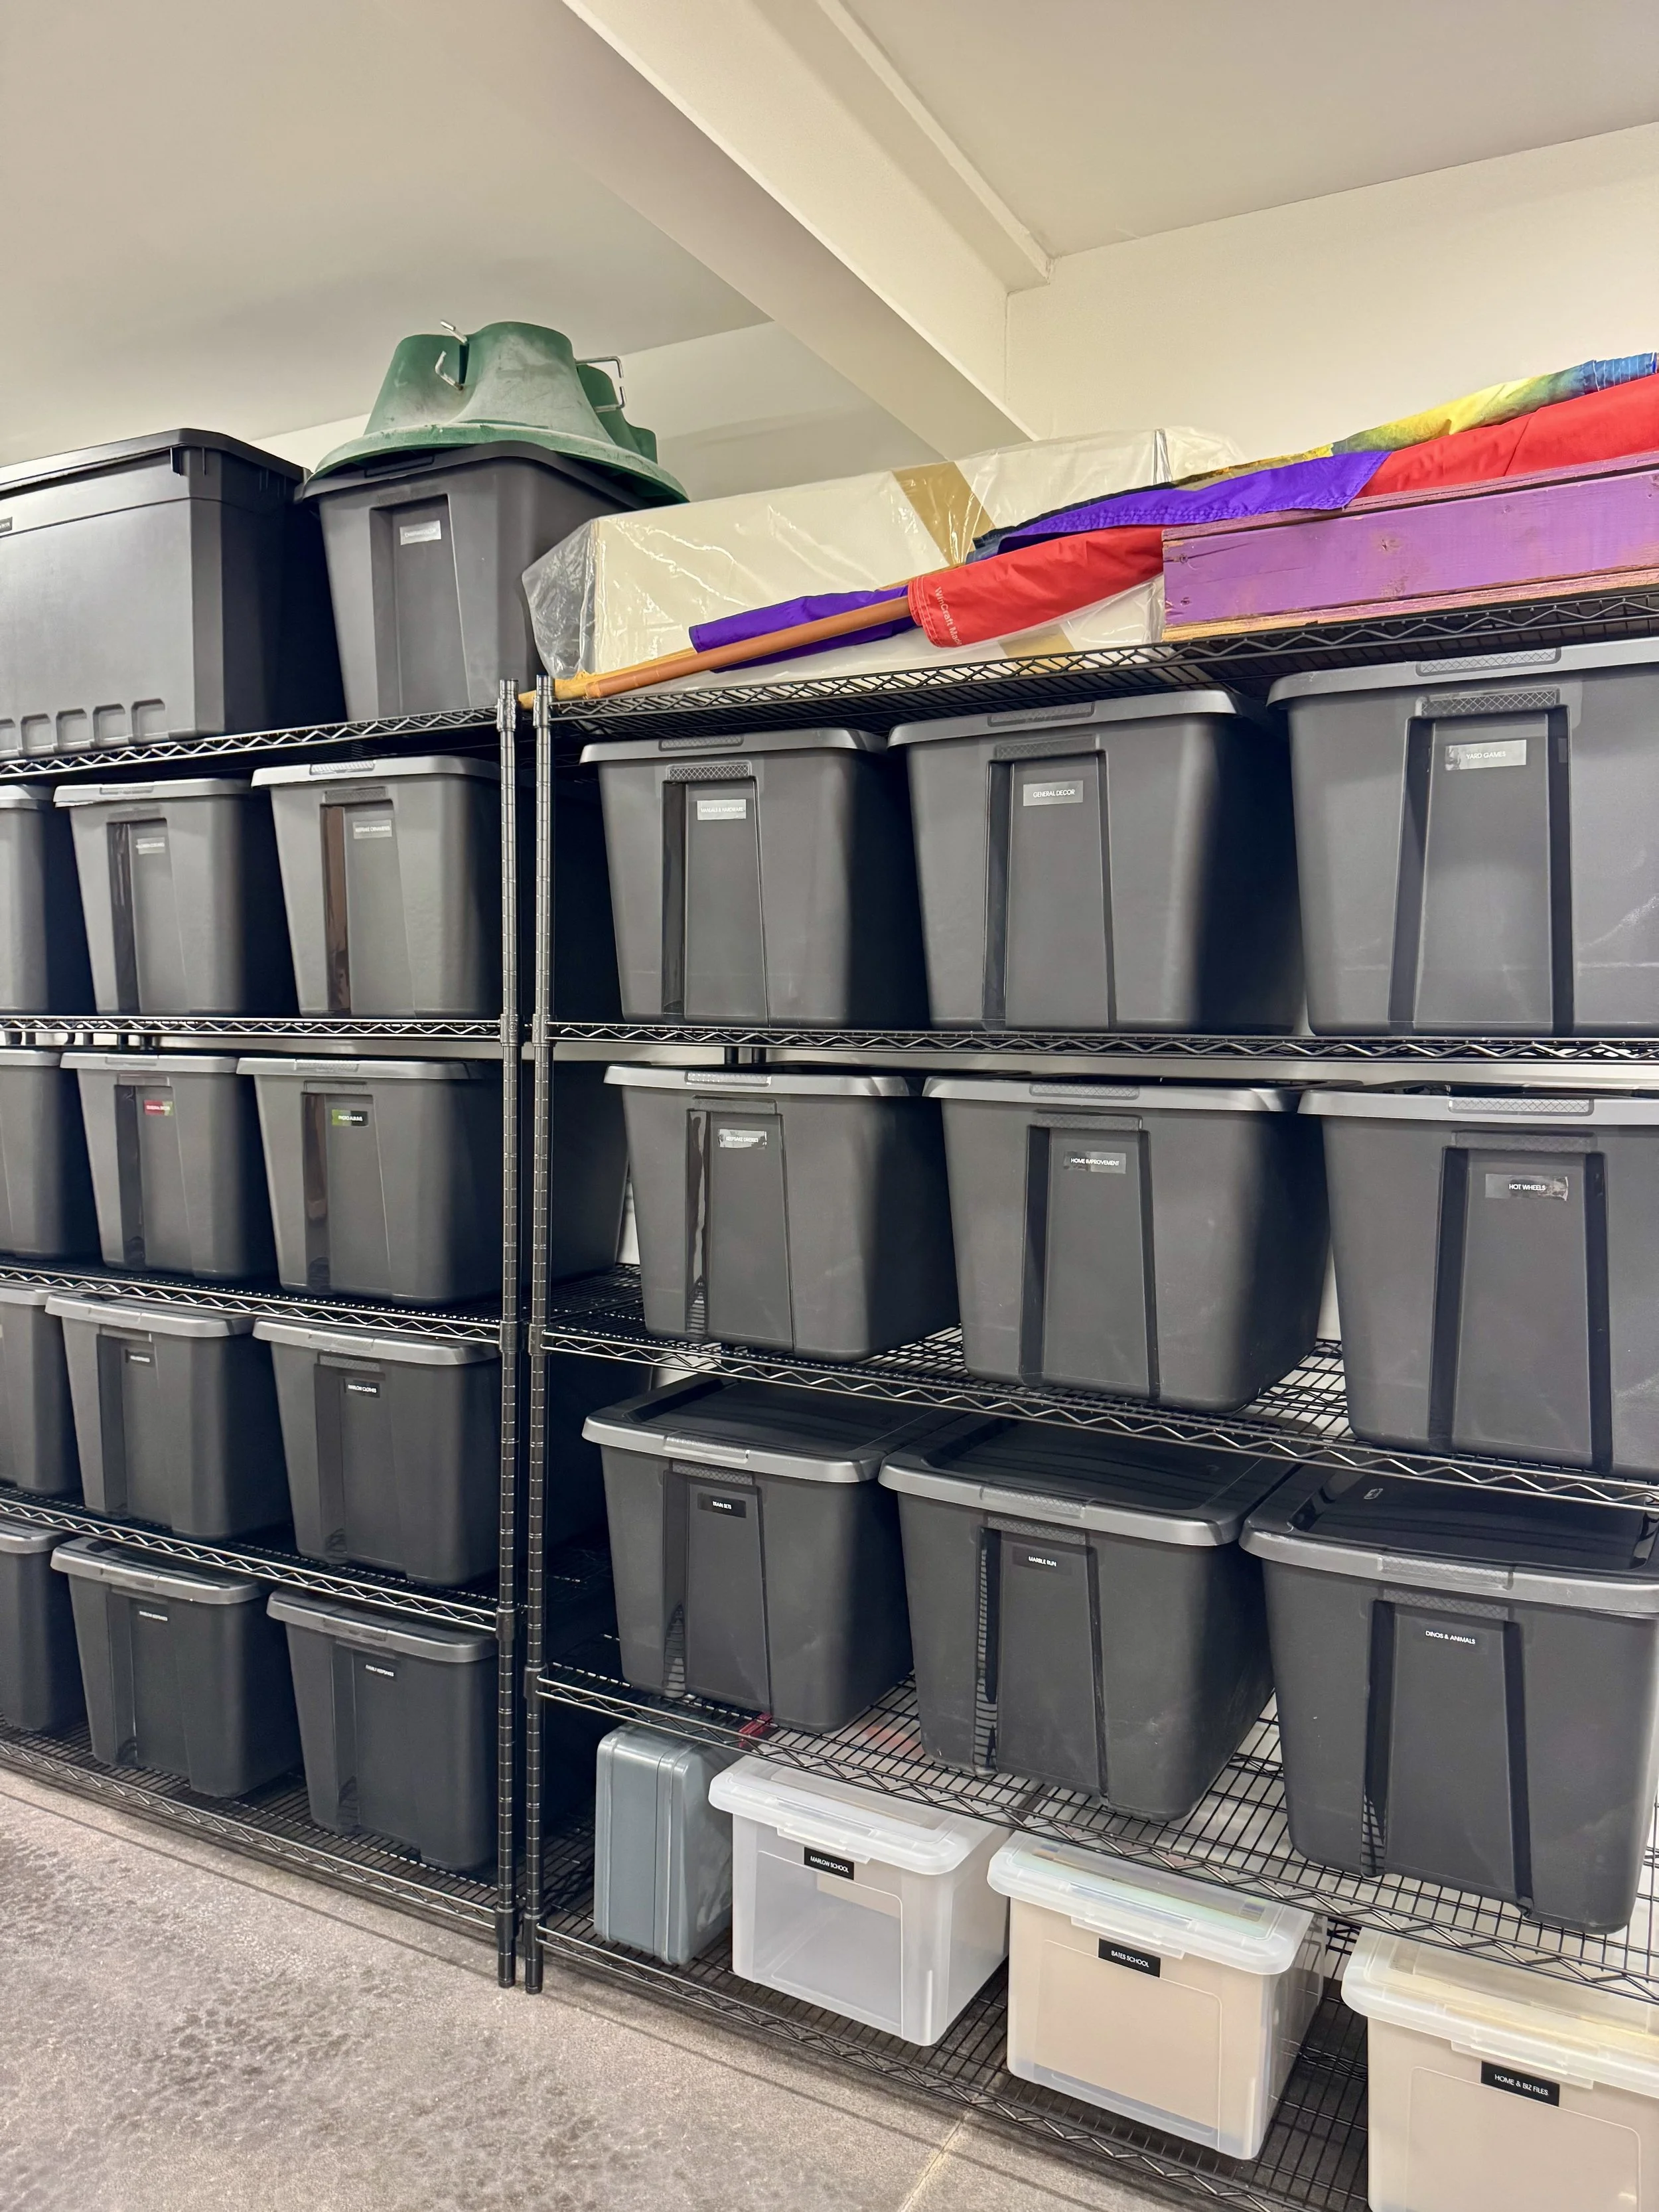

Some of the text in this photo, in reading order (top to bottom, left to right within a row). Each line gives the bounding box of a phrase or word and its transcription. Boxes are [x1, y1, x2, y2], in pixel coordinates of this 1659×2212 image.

[935, 586, 954, 627] WinCraft
[1028, 1556, 1046, 1565] MARBLE
[1425, 1630, 1444, 1639] DINOS
[1449, 1635, 1476, 1645] ANIMALS
[810, 1856, 849, 1874] MARLOW SCHOOL
[1111, 1950, 1150, 1968] BATES SCHOOL
[1494, 2073, 1514, 2085] HOME
[1522, 2082, 1532, 2091] BIZ
[1532, 2085, 1549, 2096] FILES
